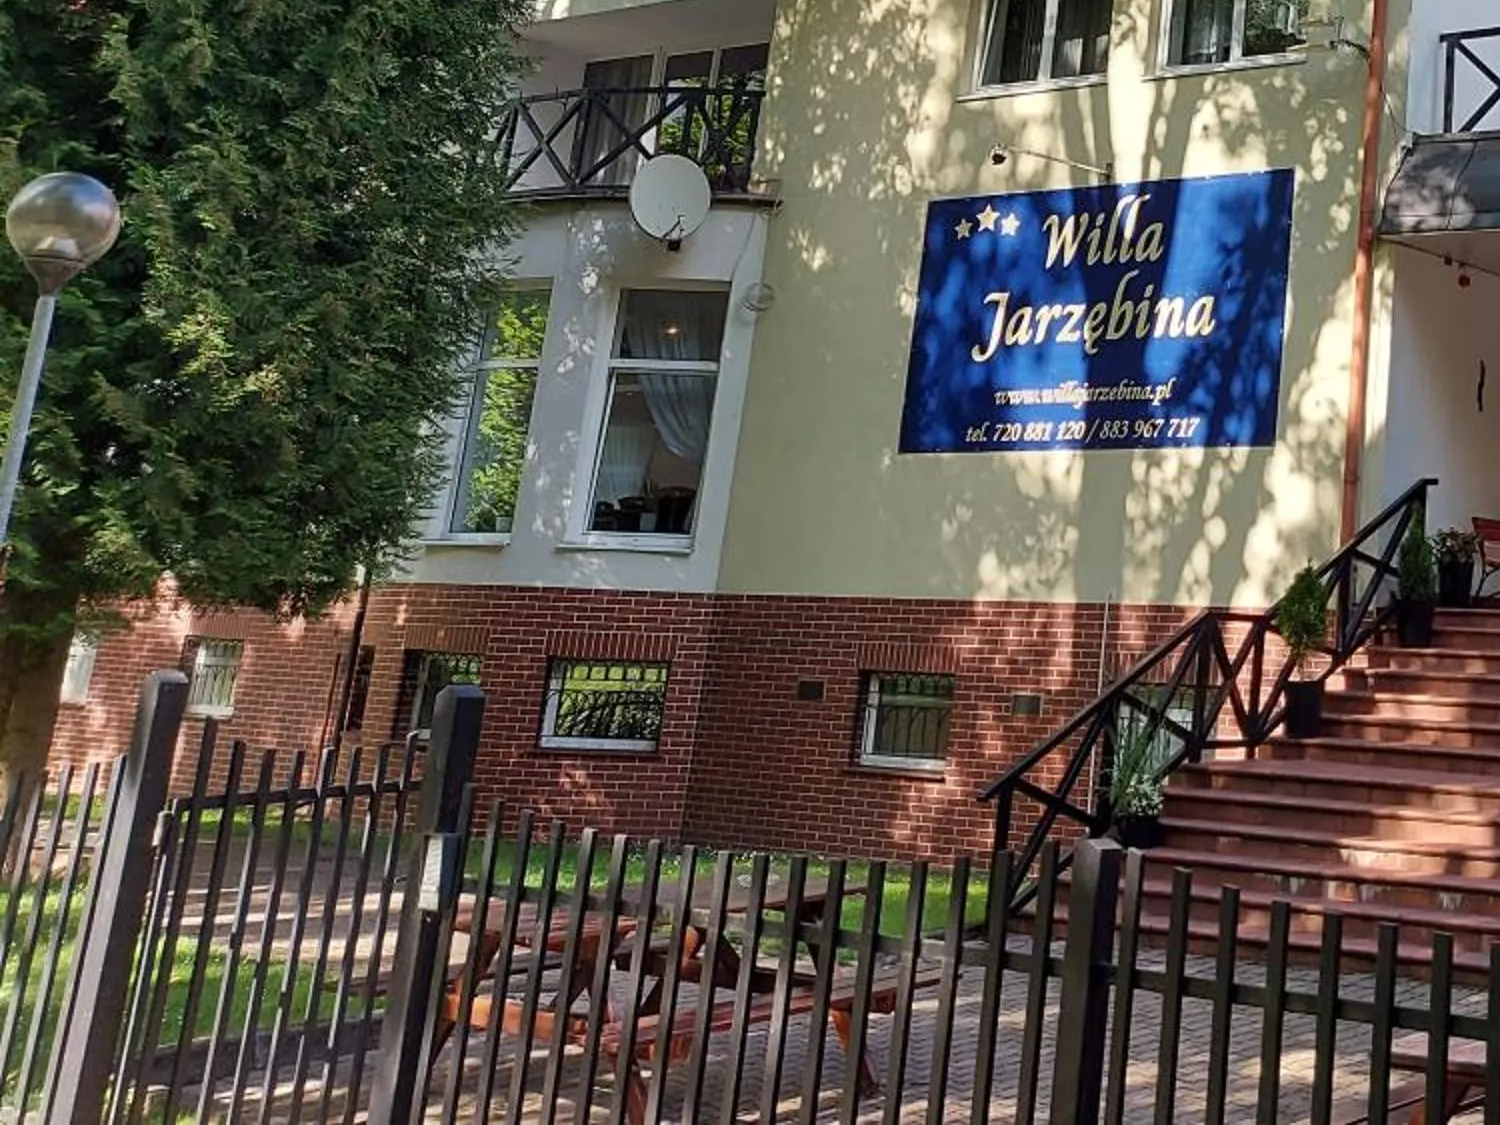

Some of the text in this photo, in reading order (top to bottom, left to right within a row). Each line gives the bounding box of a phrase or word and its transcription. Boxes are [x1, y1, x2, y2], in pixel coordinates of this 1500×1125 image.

[1042, 194, 1165, 270] Willa
[971, 269, 1216, 363] Jarzębina
[994, 377, 1176, 409] www.willajarzebina.pl
[965, 421, 990, 442] tel.
[993, 422, 1023, 442] 720
[1023, 421, 1054, 442] 881
[1056, 420, 1086, 441] 120
[1100, 420, 1129, 439] 883
[1132, 418, 1165, 438] 967
[1167, 417, 1200, 438] 717
